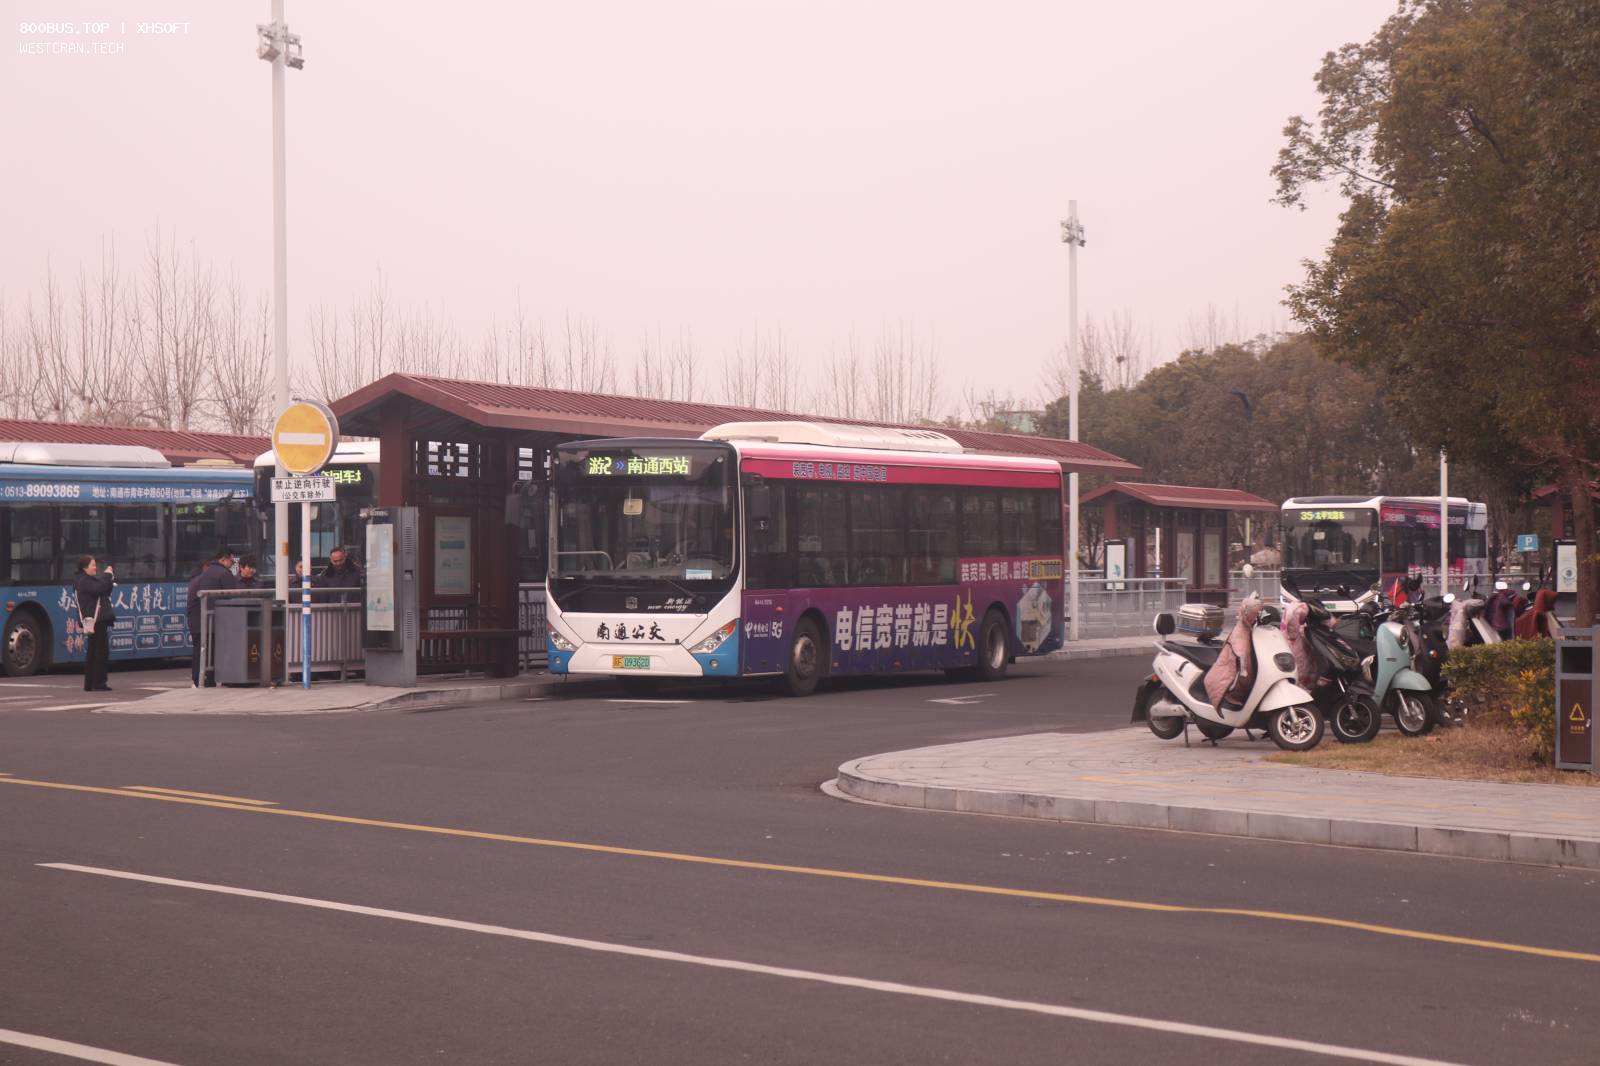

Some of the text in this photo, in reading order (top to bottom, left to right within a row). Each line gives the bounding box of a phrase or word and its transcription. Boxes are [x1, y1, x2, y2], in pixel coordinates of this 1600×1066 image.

[627, 456, 690, 475] 南通西站
[275, 478, 331, 490] 禁止逆向行驶
[1525, 536, 1533, 547] P
[835, 587, 976, 651] 电信宽带就是快
[596, 621, 666, 641] 南通公交
[771, 620, 783, 639] 5G
